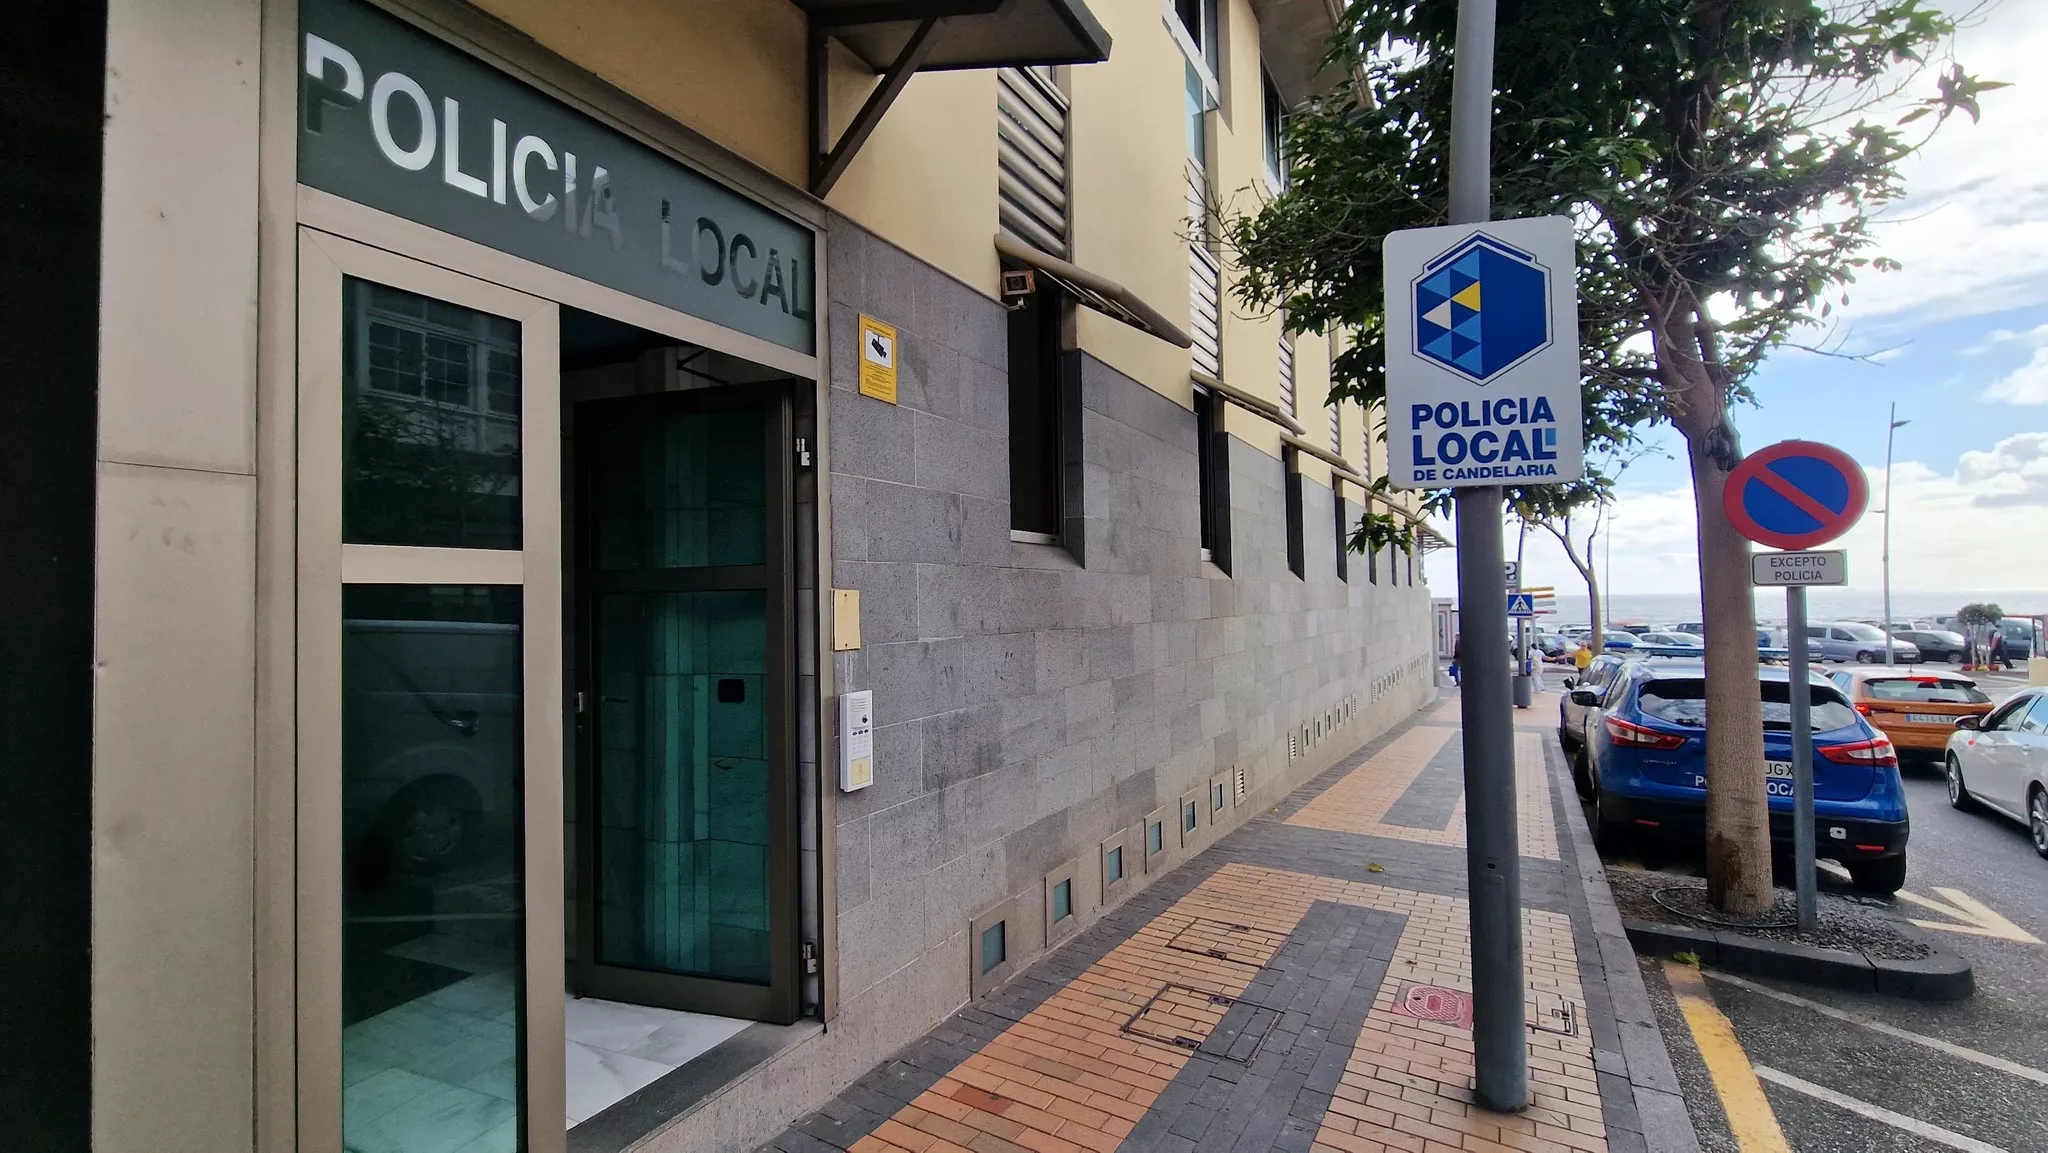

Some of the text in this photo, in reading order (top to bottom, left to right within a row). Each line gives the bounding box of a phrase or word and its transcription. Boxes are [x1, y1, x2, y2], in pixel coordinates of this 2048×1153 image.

[305, 32, 808, 320] POLICIA LOCAL
[1412, 397, 1555, 430] POLICIA
[1412, 428, 1557, 466] LOCAL
[1413, 464, 1557, 481] DE CANDELARIA
[1770, 556, 1826, 568] EXCEPTO
[1774, 570, 1822, 581] POLICIA
